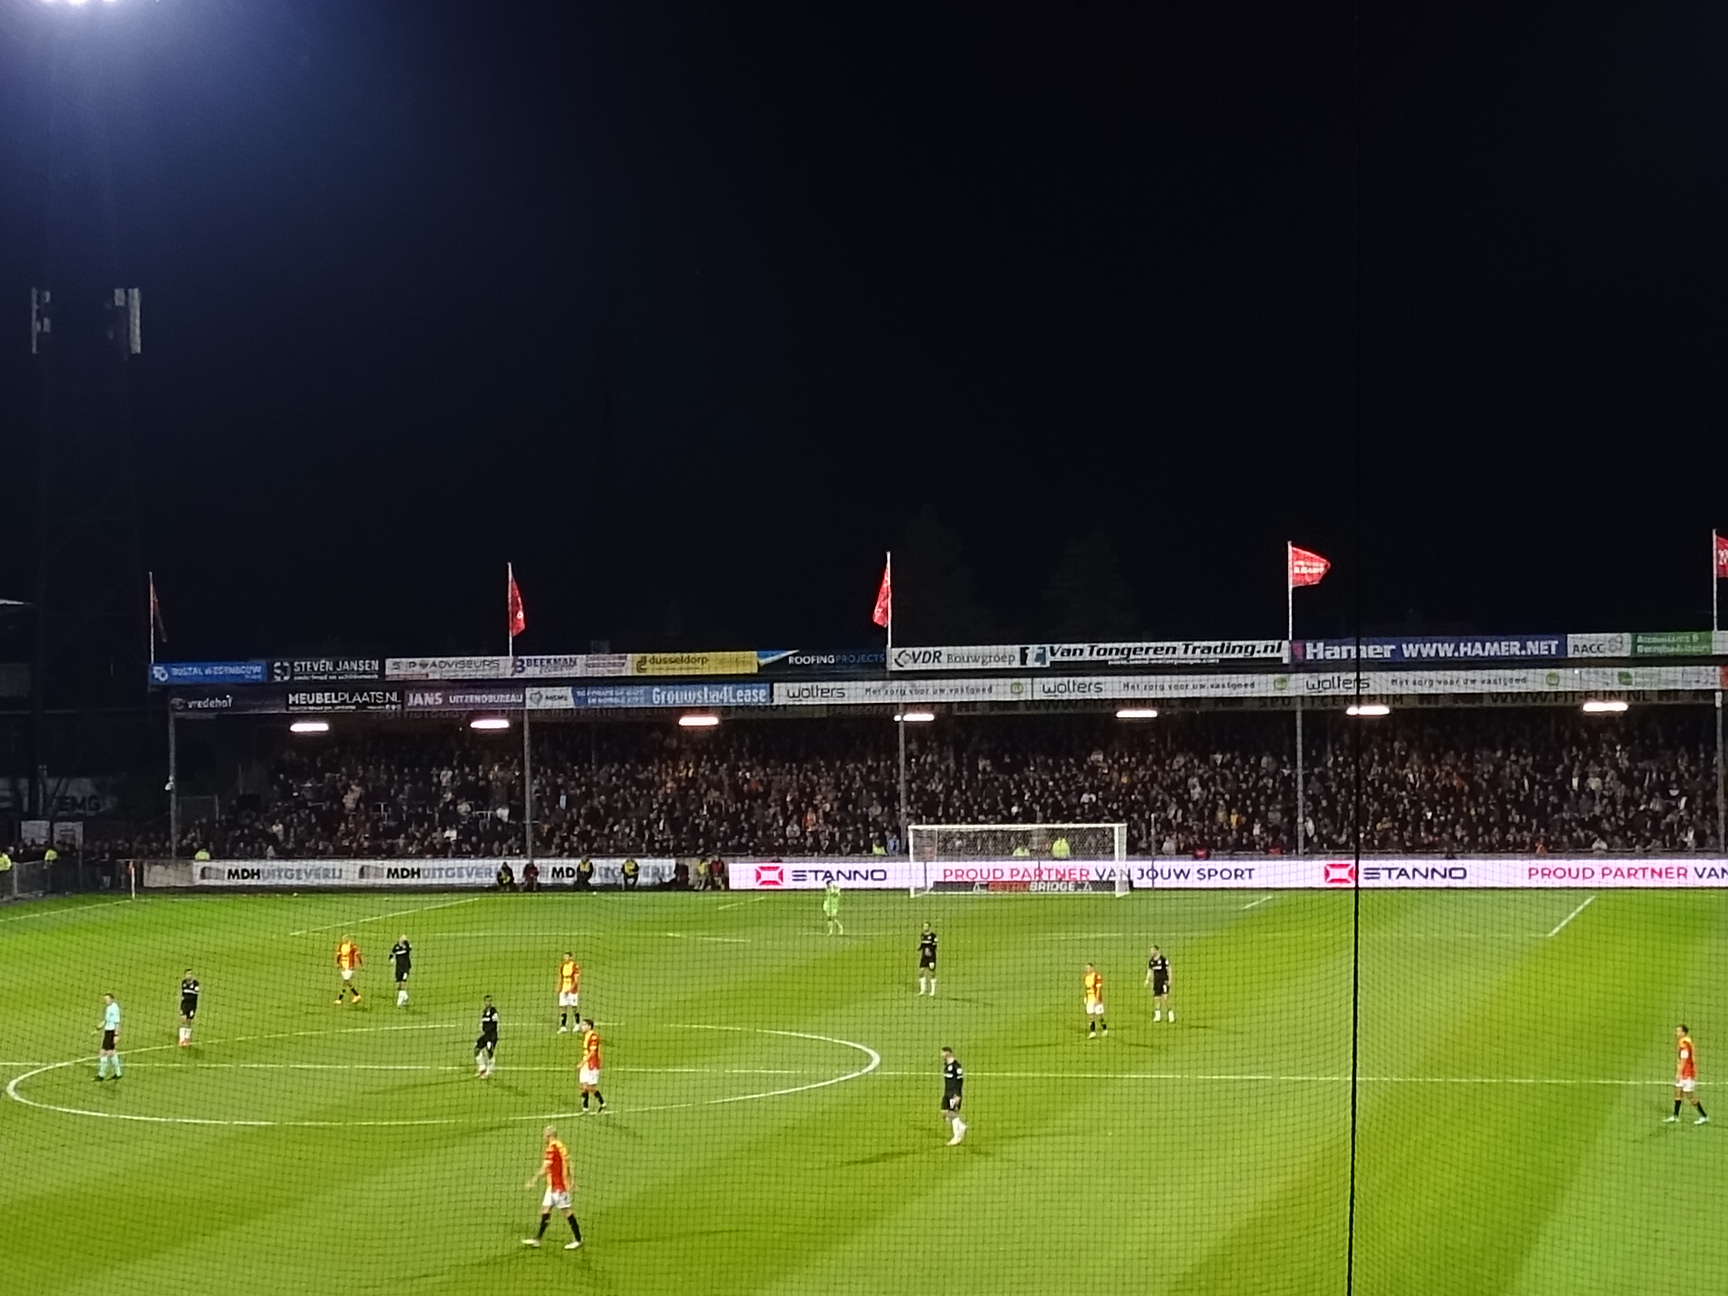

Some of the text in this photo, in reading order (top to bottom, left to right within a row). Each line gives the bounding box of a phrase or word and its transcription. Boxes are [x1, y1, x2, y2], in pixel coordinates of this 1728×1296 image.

[1182, 641, 1283, 658] Trading.nl
[1305, 639, 1559, 661] Hamer WWW.HAMER.NET
[1572, 642, 1605, 654] AACC
[336, 659, 380, 672] JANSEN
[526, 657, 578, 667] BEEKMAN
[911, 650, 1016, 666] VDR Bouwgroep
[1041, 680, 1103, 696] wolters
[1305, 675, 1370, 692] wolters
[288, 691, 402, 706] MEUBELPLAATS.NL
[407, 692, 523, 706] JANS UITZENDBUREAU
[786, 684, 846, 699] wolters
[1257, 692, 1404, 707] SPOTCENTRUM
[790, 868, 888, 882] STANNO
[942, 867, 1005, 882] PROUD
[1009, 867, 1090, 882] PARTNER
[1094, 867, 1131, 881] VAN
[1136, 867, 1192, 881] JOUW
[1196, 867, 1256, 881] SPORT
[1362, 866, 1468, 880] STANNO
[1527, 866, 1596, 881] PROUD
[1600, 866, 1689, 880] PARTNER
